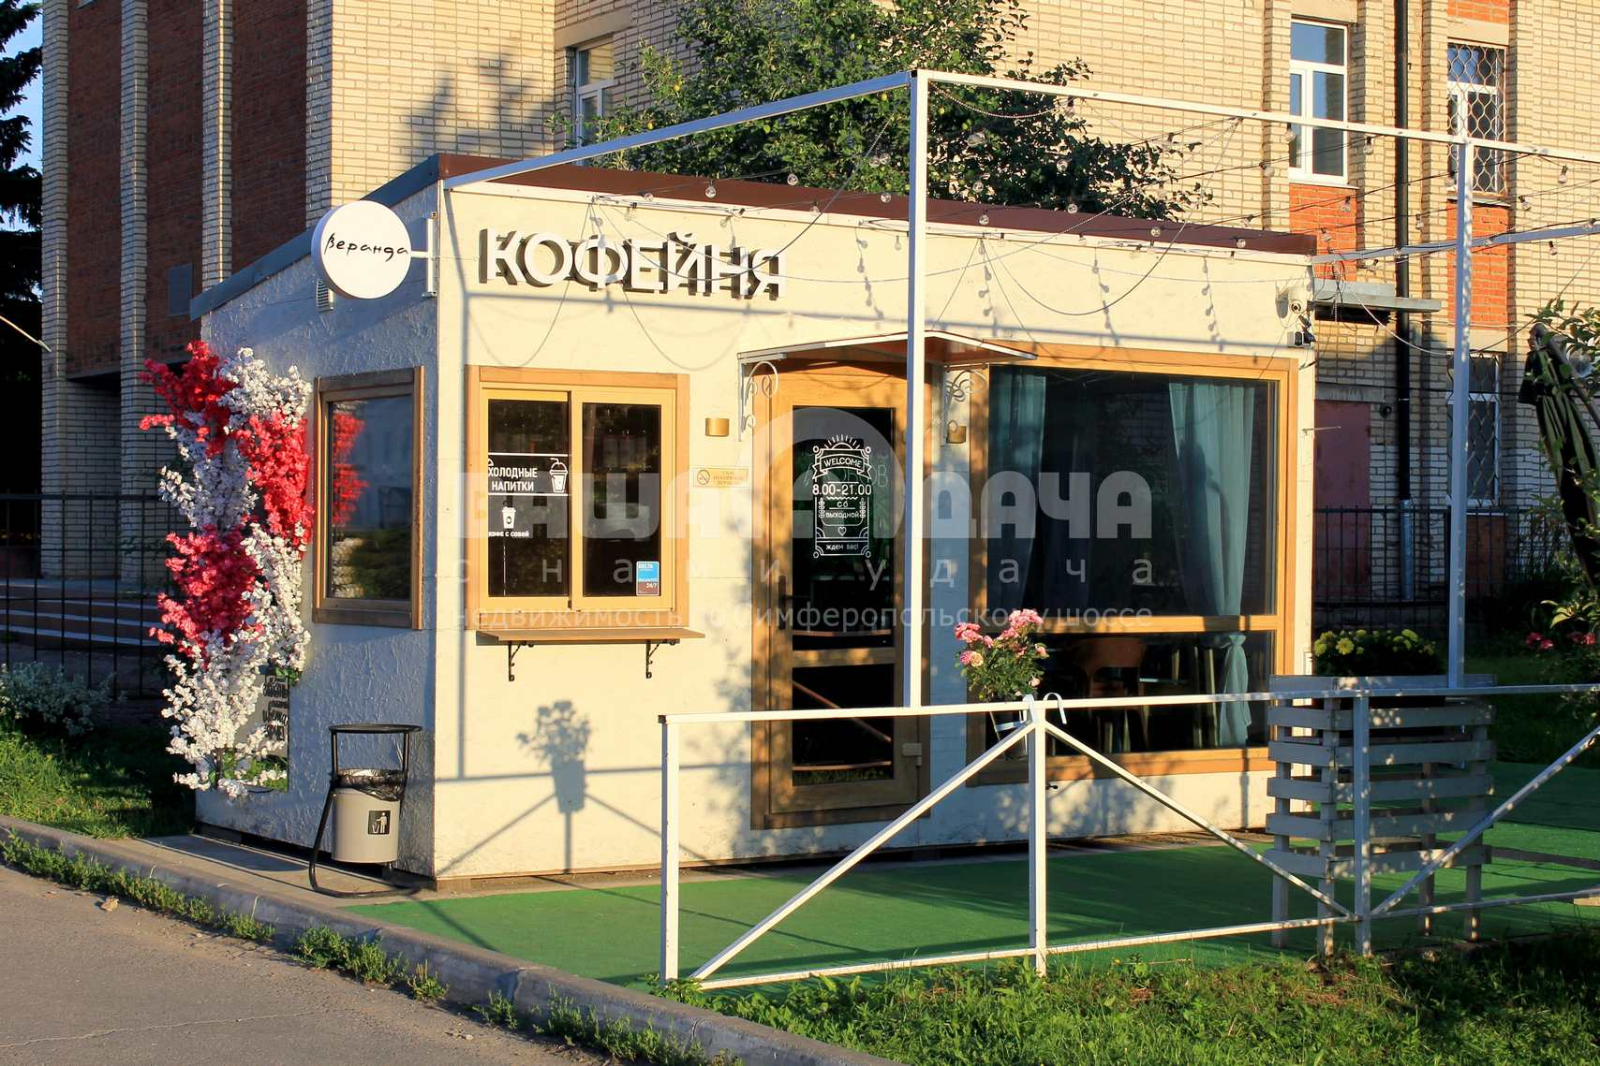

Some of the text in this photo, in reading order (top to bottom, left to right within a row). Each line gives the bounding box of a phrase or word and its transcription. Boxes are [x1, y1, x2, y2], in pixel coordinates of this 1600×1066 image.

[323, 232, 409, 263] Веранда
[479, 228, 788, 301] КОФЕЙНЯ
[823, 456, 862, 469] WELCOME
[488, 467, 538, 480] ХОЛОДНЫЕ
[491, 480, 535, 492] НАПИТКИ
[812, 484, 872, 496] 8.00-21.00
